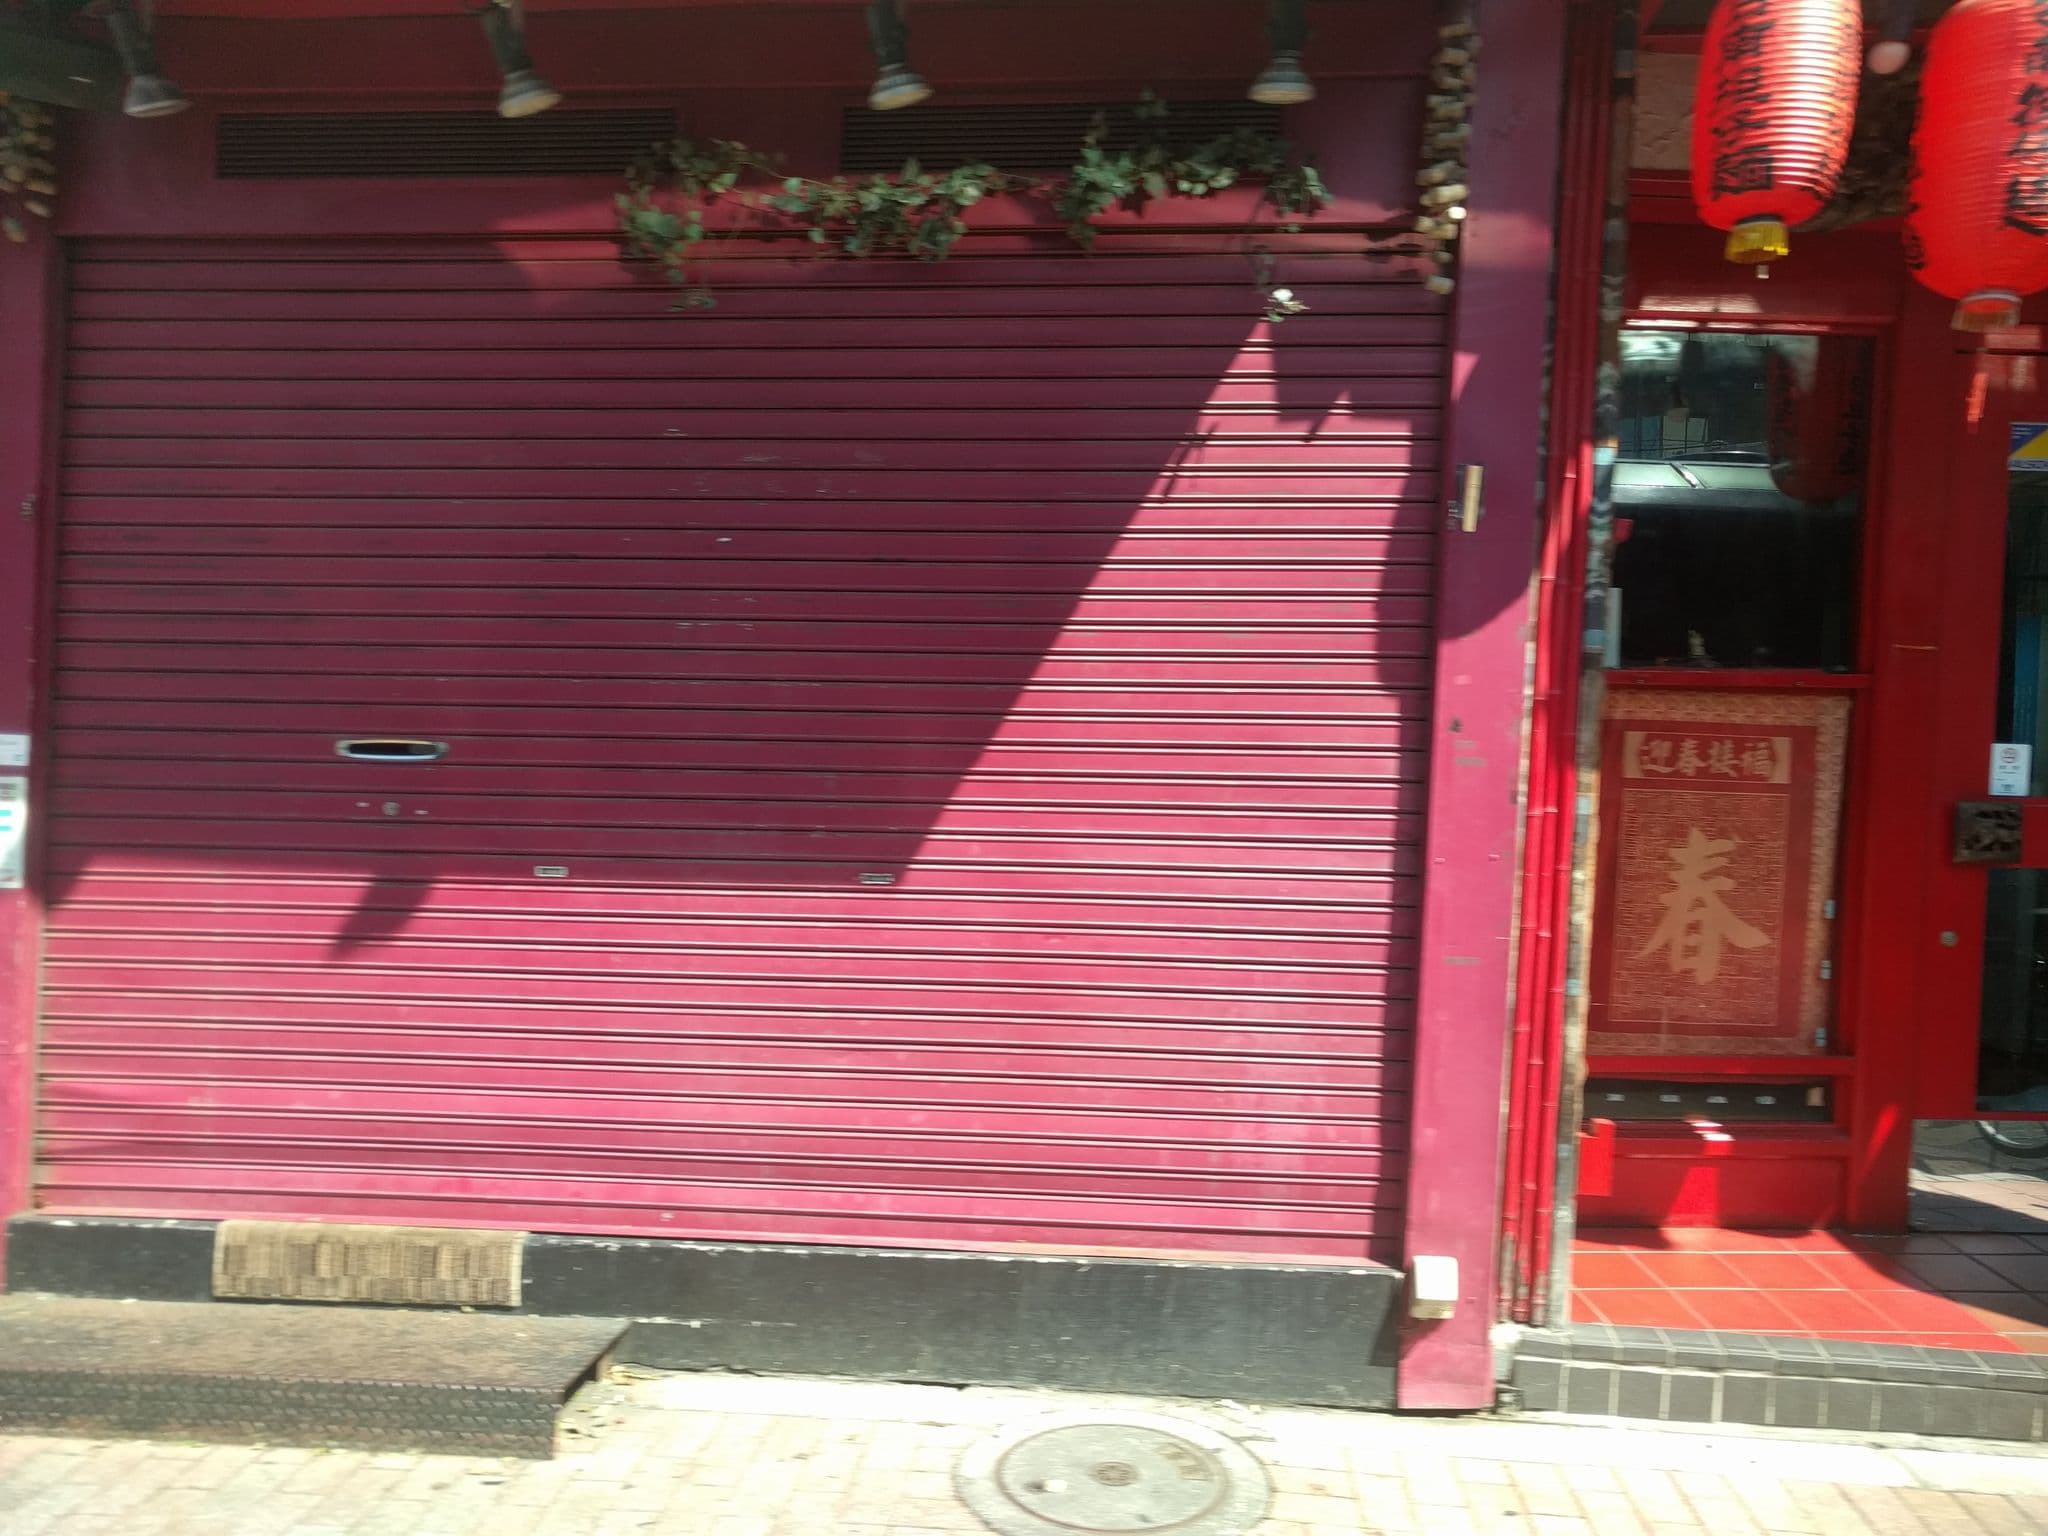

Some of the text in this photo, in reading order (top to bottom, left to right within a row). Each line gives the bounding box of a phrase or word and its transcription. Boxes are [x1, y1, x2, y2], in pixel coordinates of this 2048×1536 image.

[1639, 738, 1772, 777] 迎春接福
[1632, 827, 1772, 985] 春
